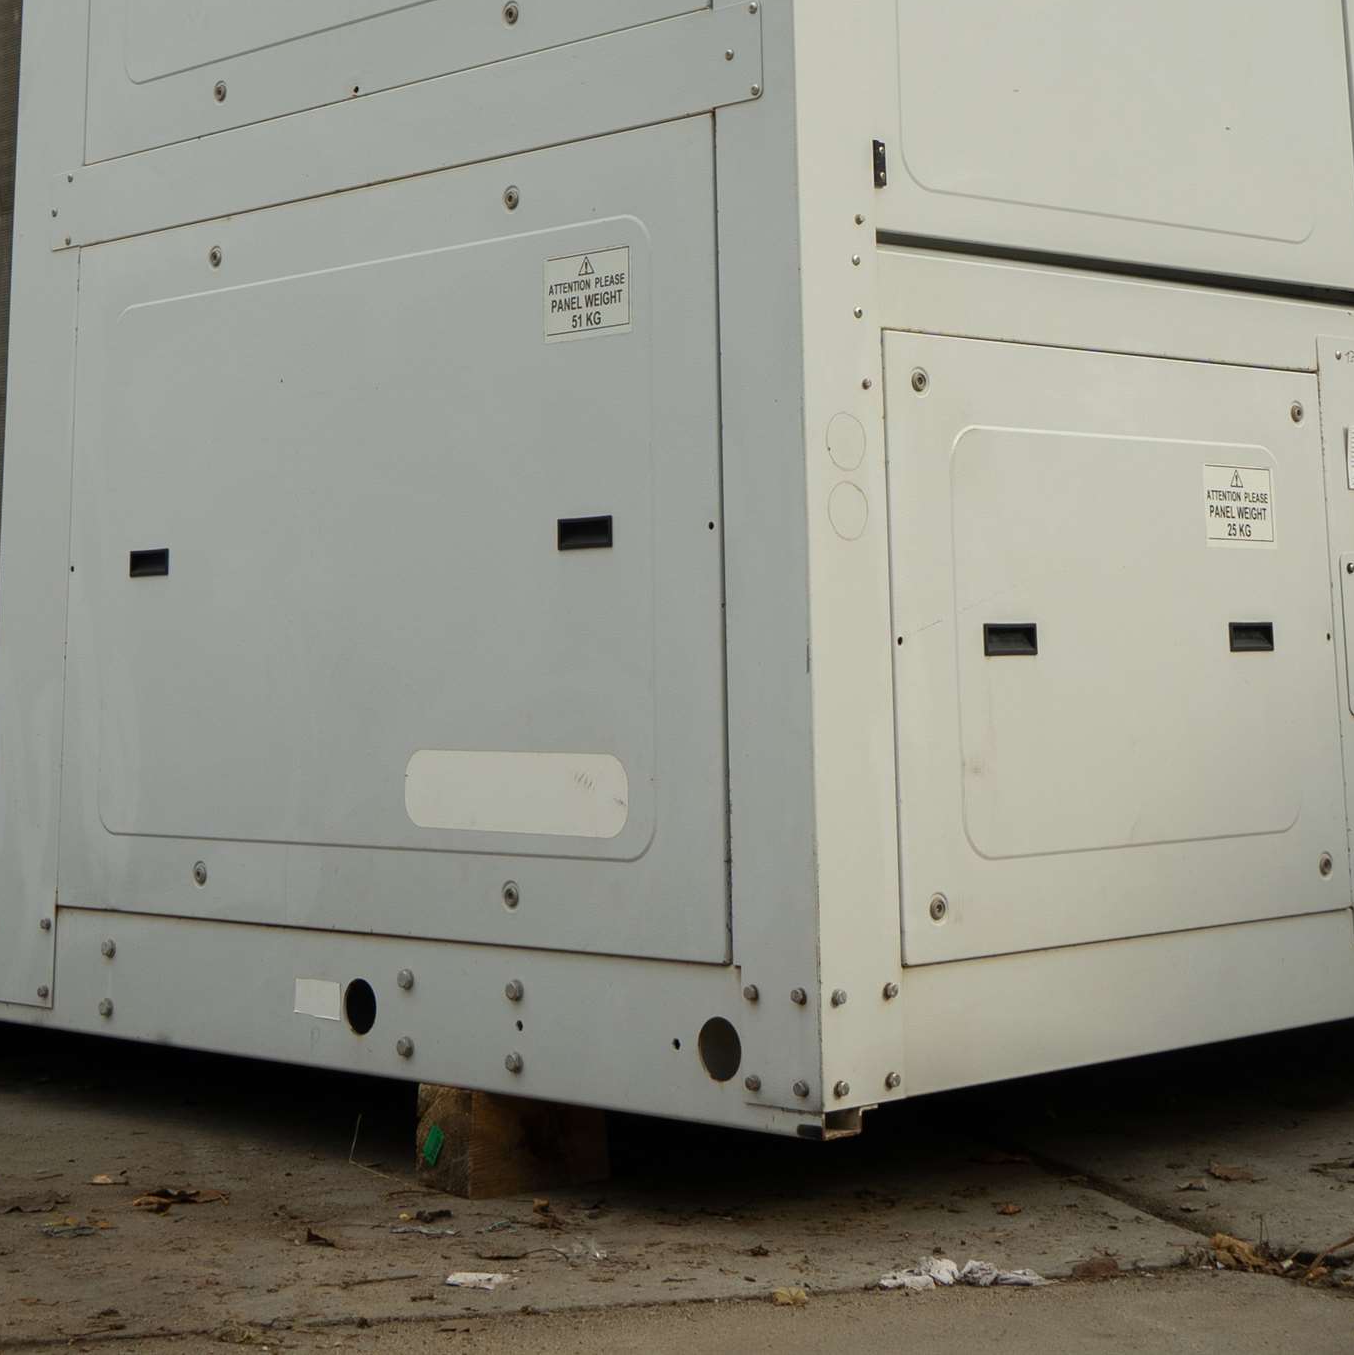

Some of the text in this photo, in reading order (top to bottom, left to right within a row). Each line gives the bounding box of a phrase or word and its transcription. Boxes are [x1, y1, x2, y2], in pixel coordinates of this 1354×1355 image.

[548, 273, 625, 296] ATTENTION PLEASE
[551, 289, 623, 313] PANEL WEIGHT
[572, 311, 601, 328] 51 KG
[1206, 490, 1268, 504] ATTENTION PLEASE
[1209, 505, 1267, 521] PANEL WEIGHT
[1227, 523, 1252, 537] 25 KG
